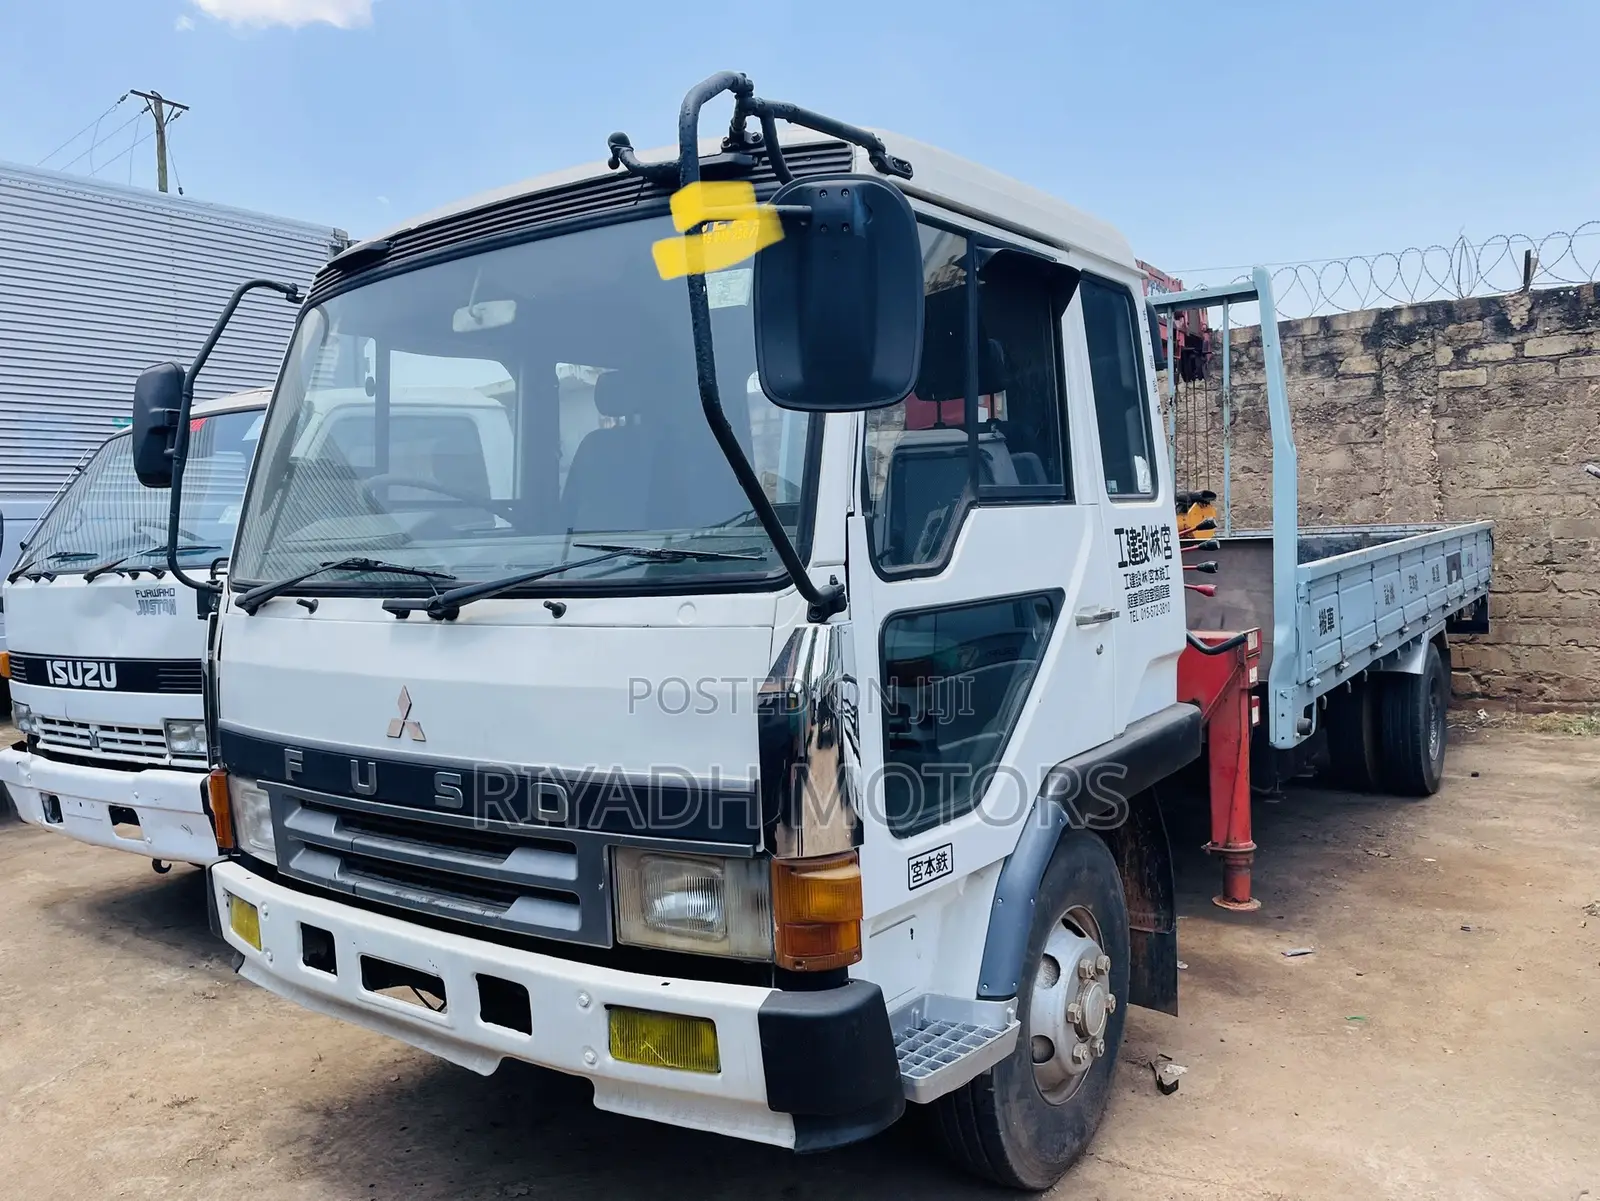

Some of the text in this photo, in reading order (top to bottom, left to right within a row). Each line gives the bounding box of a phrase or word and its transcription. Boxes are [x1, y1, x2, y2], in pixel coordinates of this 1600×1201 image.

[1129, 610, 1139, 622] TEL
[46, 660, 117, 688] ISUZU
[911, 851, 948, 883] 宮本鉄
